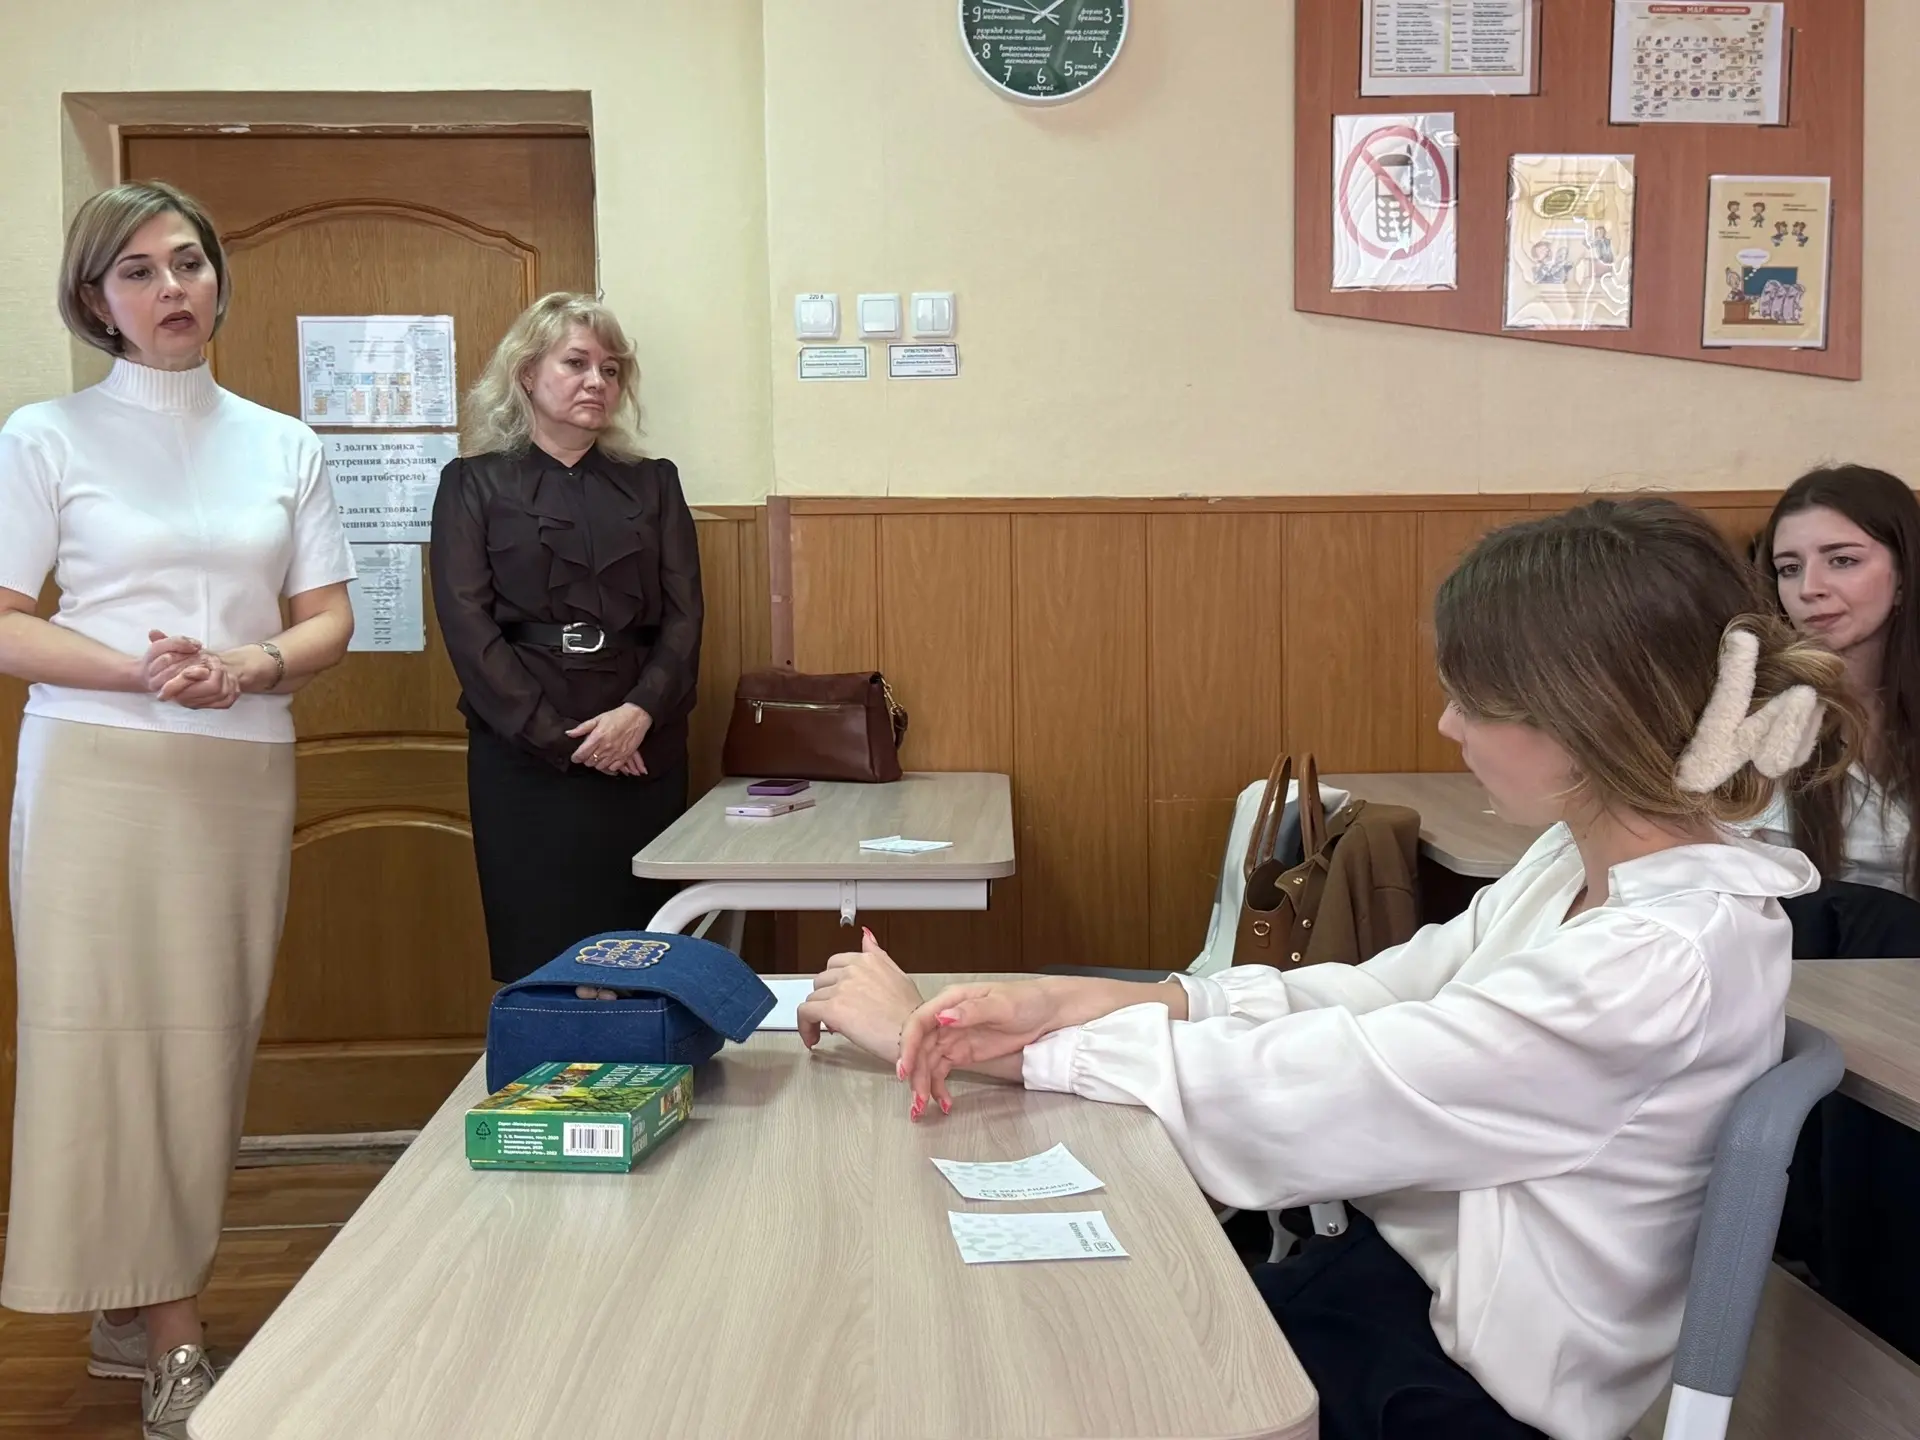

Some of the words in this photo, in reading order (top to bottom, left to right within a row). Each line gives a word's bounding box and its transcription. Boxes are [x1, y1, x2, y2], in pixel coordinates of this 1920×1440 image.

[972, 6, 981, 23] 9
[1104, 7, 1112, 24] 3
[982, 42, 991, 59] 8
[1092, 41, 1103, 58] 4
[1003, 65, 1012, 82] 7
[1037, 67, 1046, 84] 6
[1064, 61, 1073, 77] 5
[335, 443, 341, 452] 3
[343, 444, 378, 452] долгих
[380, 443, 415, 451] звонка
[384, 457, 437, 467] эвакуация
[335, 473, 359, 484] (при
[361, 472, 426, 484] артобстреле)
[338, 506, 344, 514] 2
[346, 507, 381, 515] долгих
[383, 505, 418, 514] звонка
